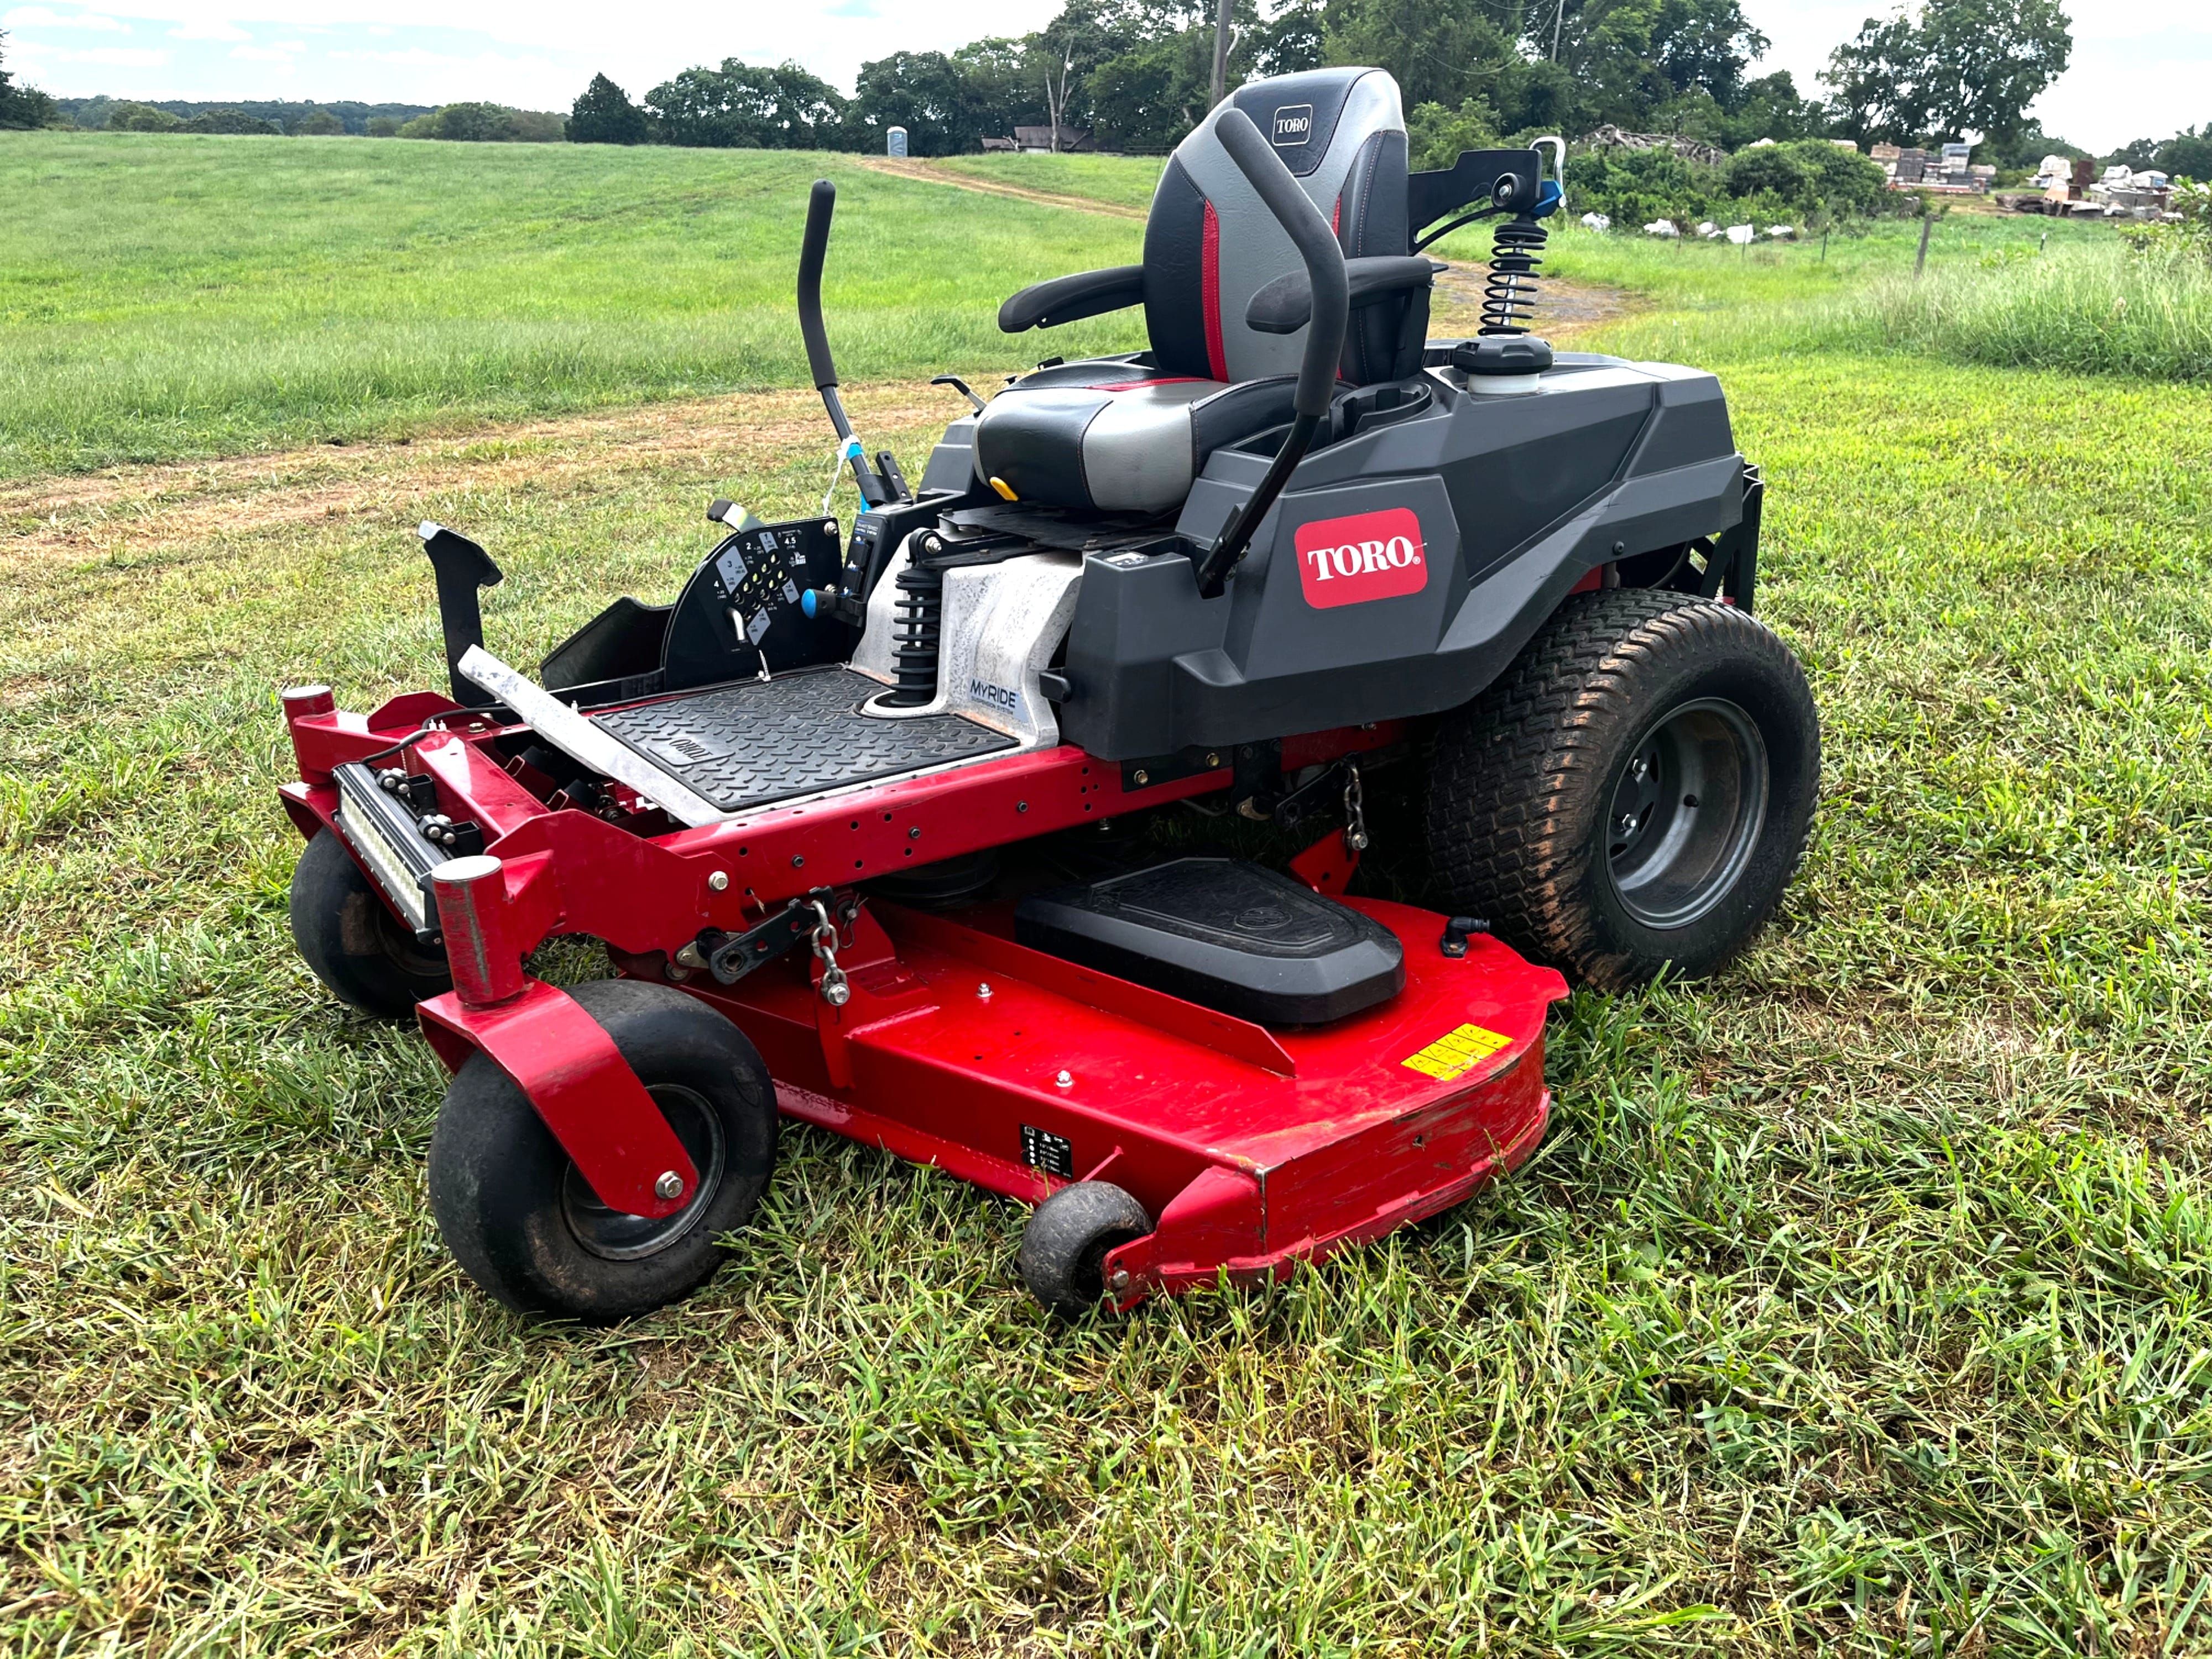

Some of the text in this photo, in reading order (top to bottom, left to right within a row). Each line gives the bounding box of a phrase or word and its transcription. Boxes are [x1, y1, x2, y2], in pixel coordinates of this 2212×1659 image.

[1277, 117, 1308, 133] TORO
[745, 542, 752, 550] 2
[784, 536, 796, 545] 4.5
[669, 739, 713, 760] TORO
